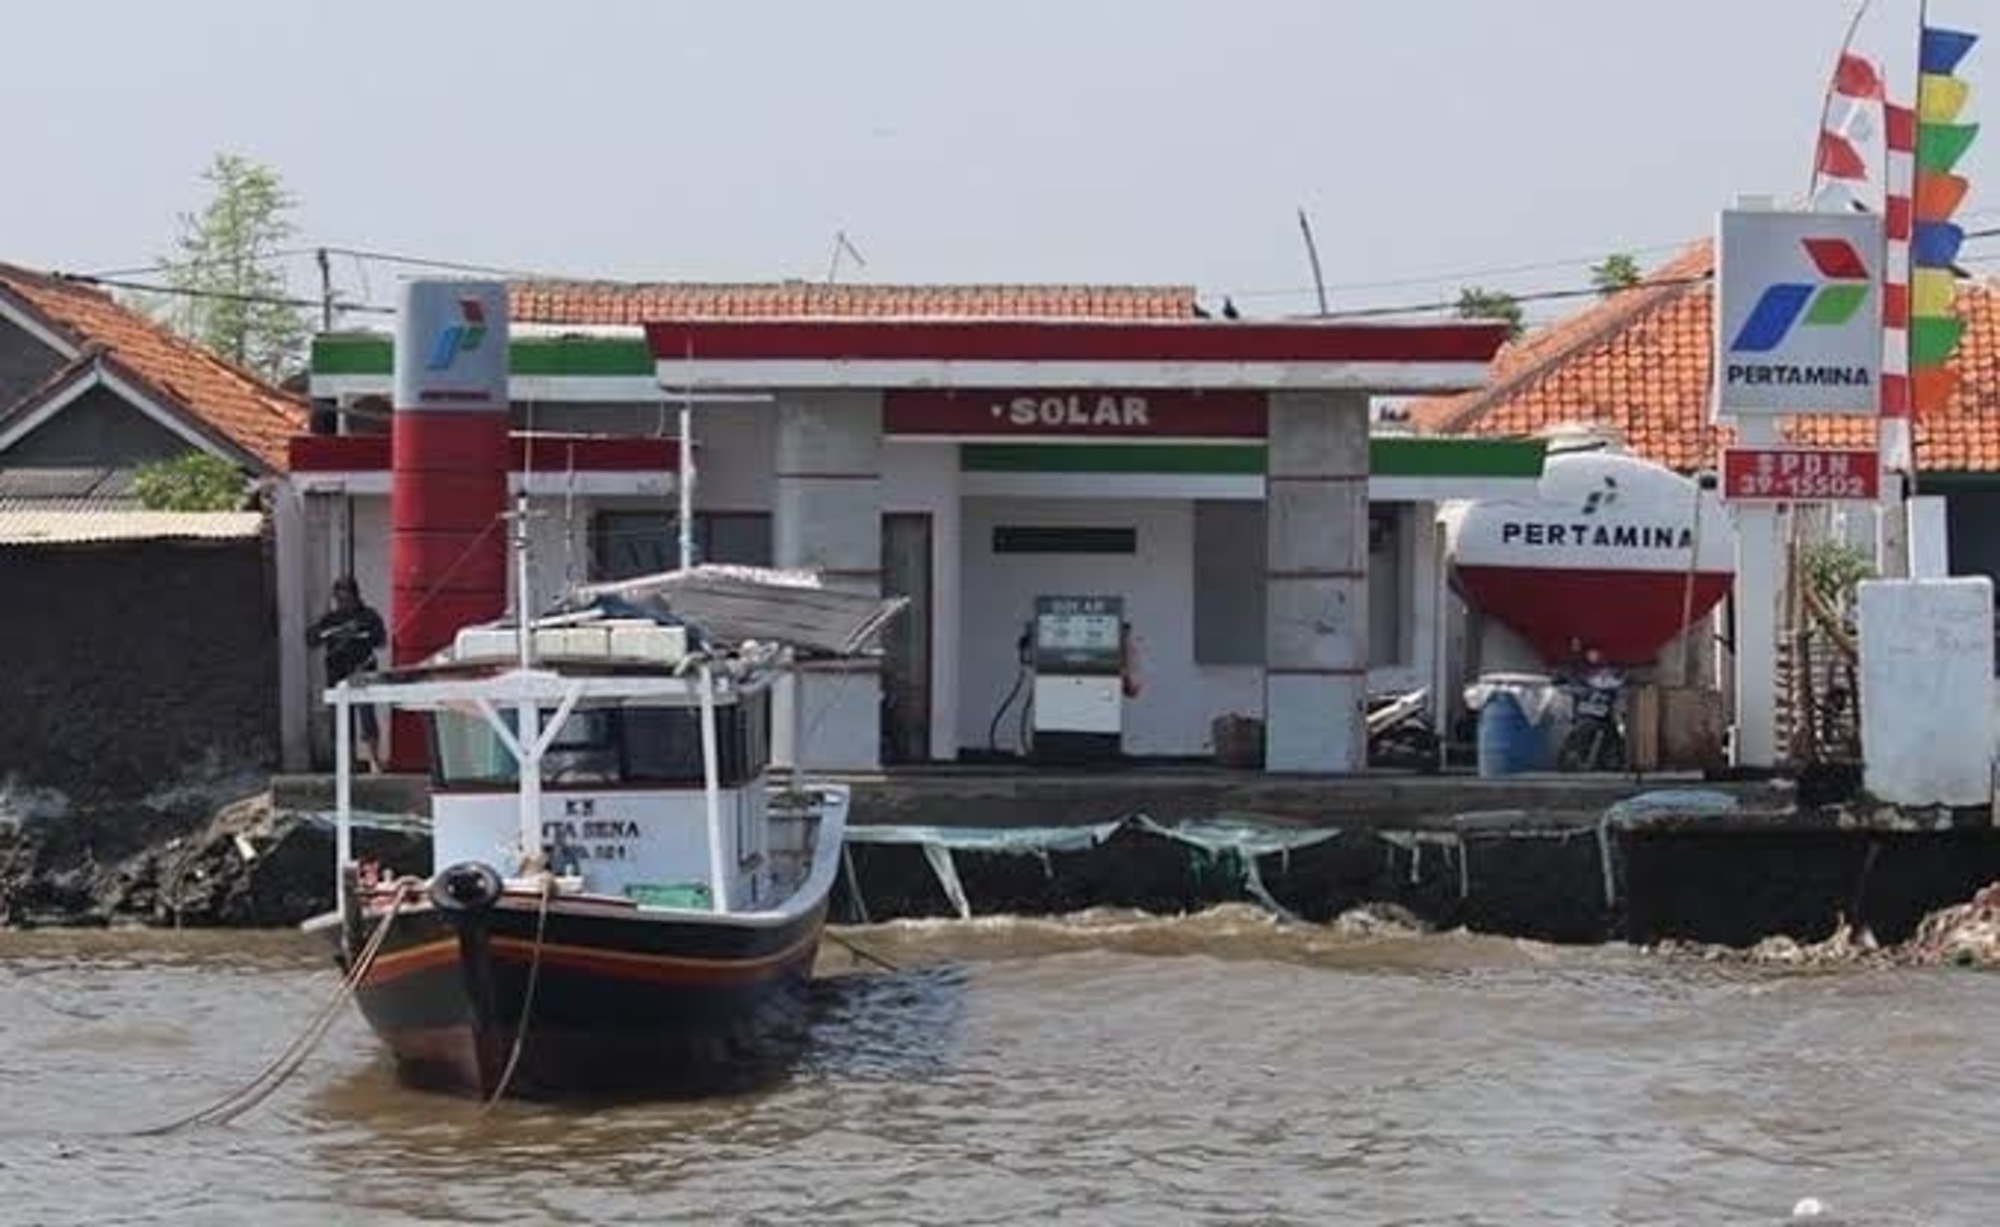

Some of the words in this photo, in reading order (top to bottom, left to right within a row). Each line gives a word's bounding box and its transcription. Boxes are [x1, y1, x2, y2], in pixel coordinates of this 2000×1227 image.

[1728, 364, 1869, 386] PERTAMINA
[1010, 397, 1149, 425] SOLAR
[1502, 523, 1693, 548] PERTAMINA
